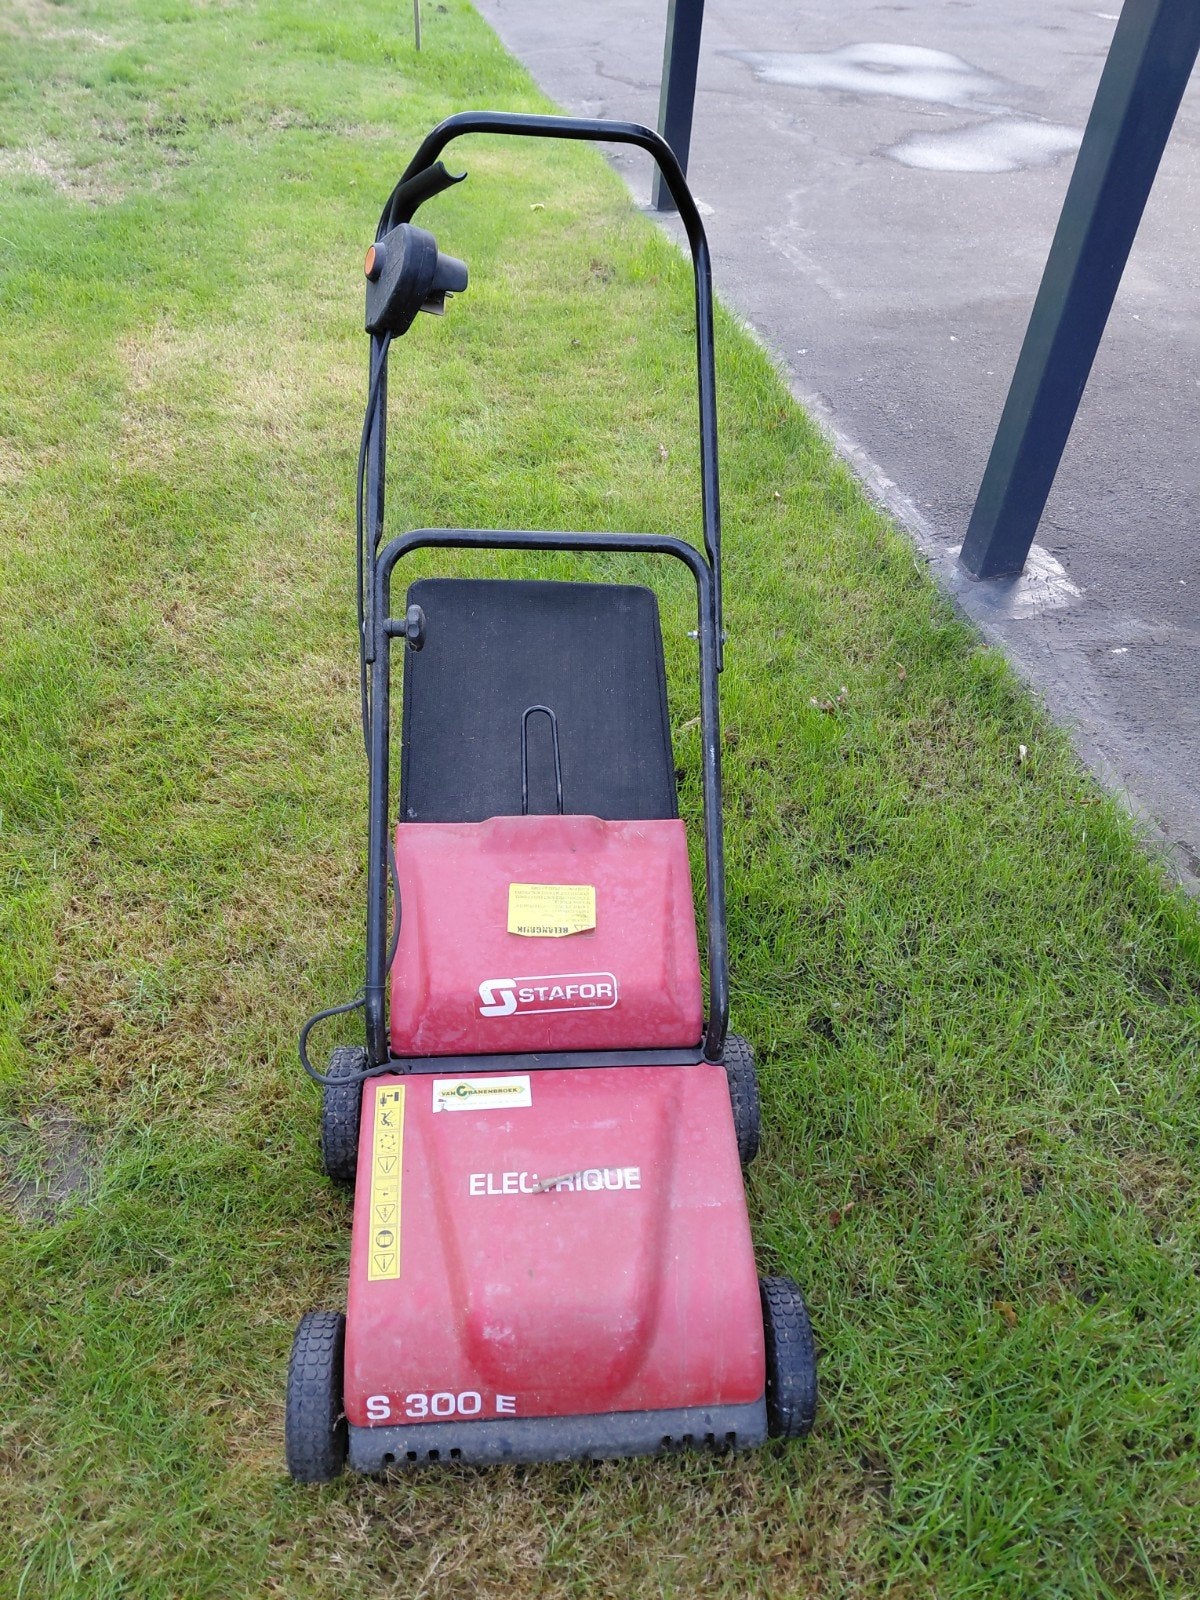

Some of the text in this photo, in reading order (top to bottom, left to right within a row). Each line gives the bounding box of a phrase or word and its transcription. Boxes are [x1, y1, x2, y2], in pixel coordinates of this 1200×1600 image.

[518, 983, 612, 1002] STAFOR
[469, 1167, 641, 1196] ELECRIQUE
[366, 1391, 517, 1420] S 300 E
